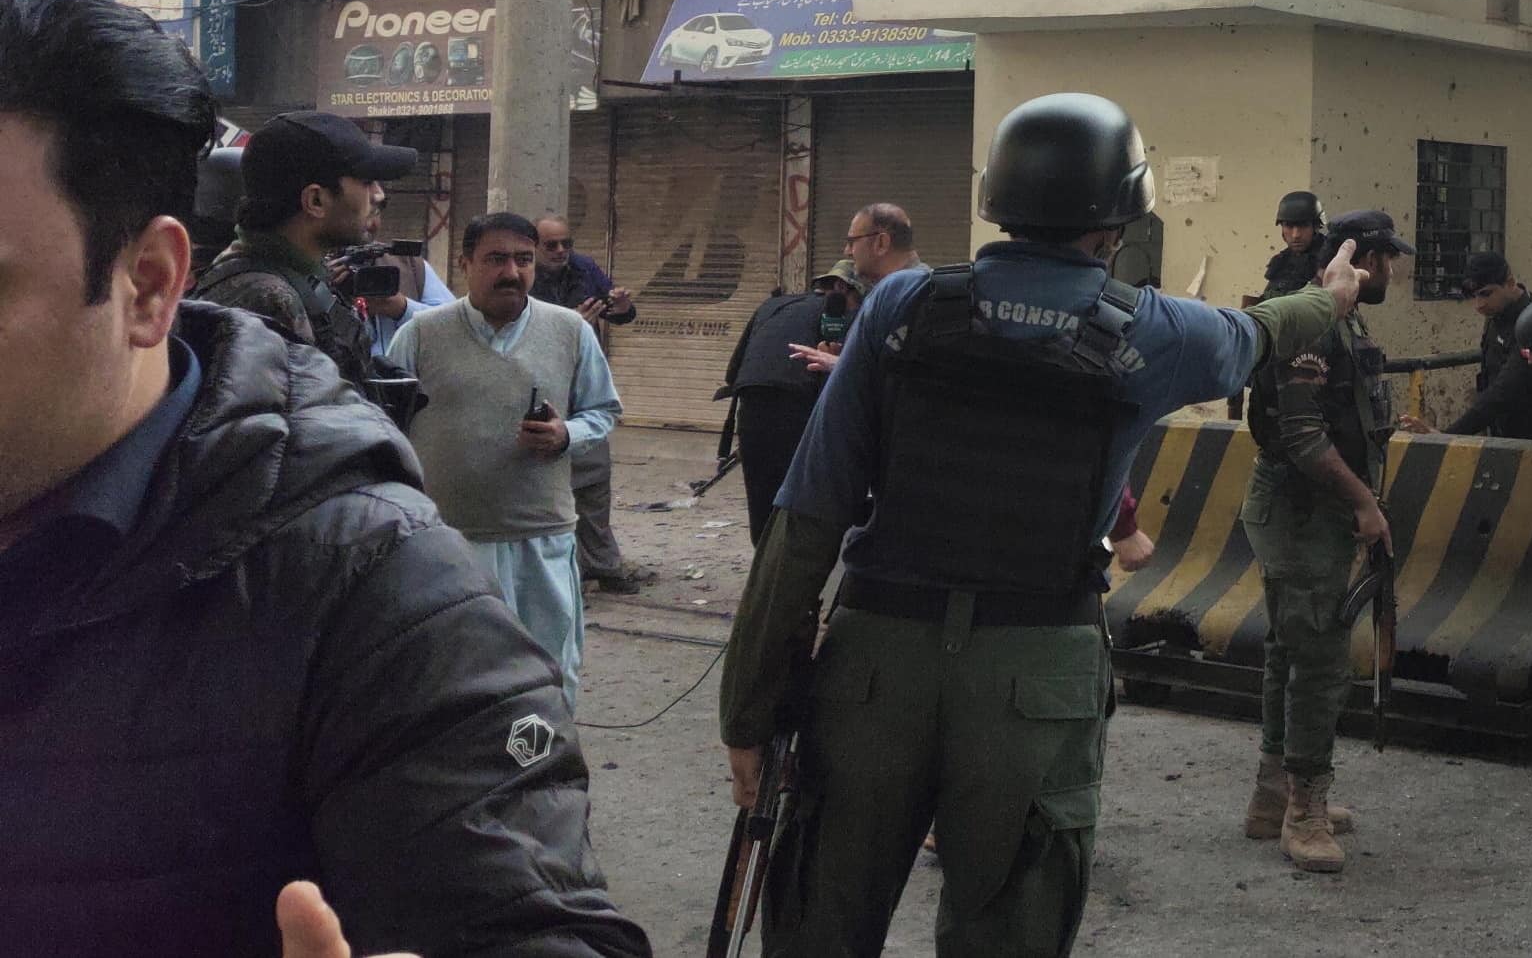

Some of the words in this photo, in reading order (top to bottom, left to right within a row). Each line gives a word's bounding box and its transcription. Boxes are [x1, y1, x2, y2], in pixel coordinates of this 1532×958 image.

[334, 0, 497, 39] Pioneer
[813, 11, 838, 27] Tel:
[778, 31, 815, 47] Mob:
[818, 26, 928, 44] 0333-9138590
[330, 93, 354, 105] STAR
[355, 90, 420, 105] ELECTRONICS
[422, 90, 430, 102] &
